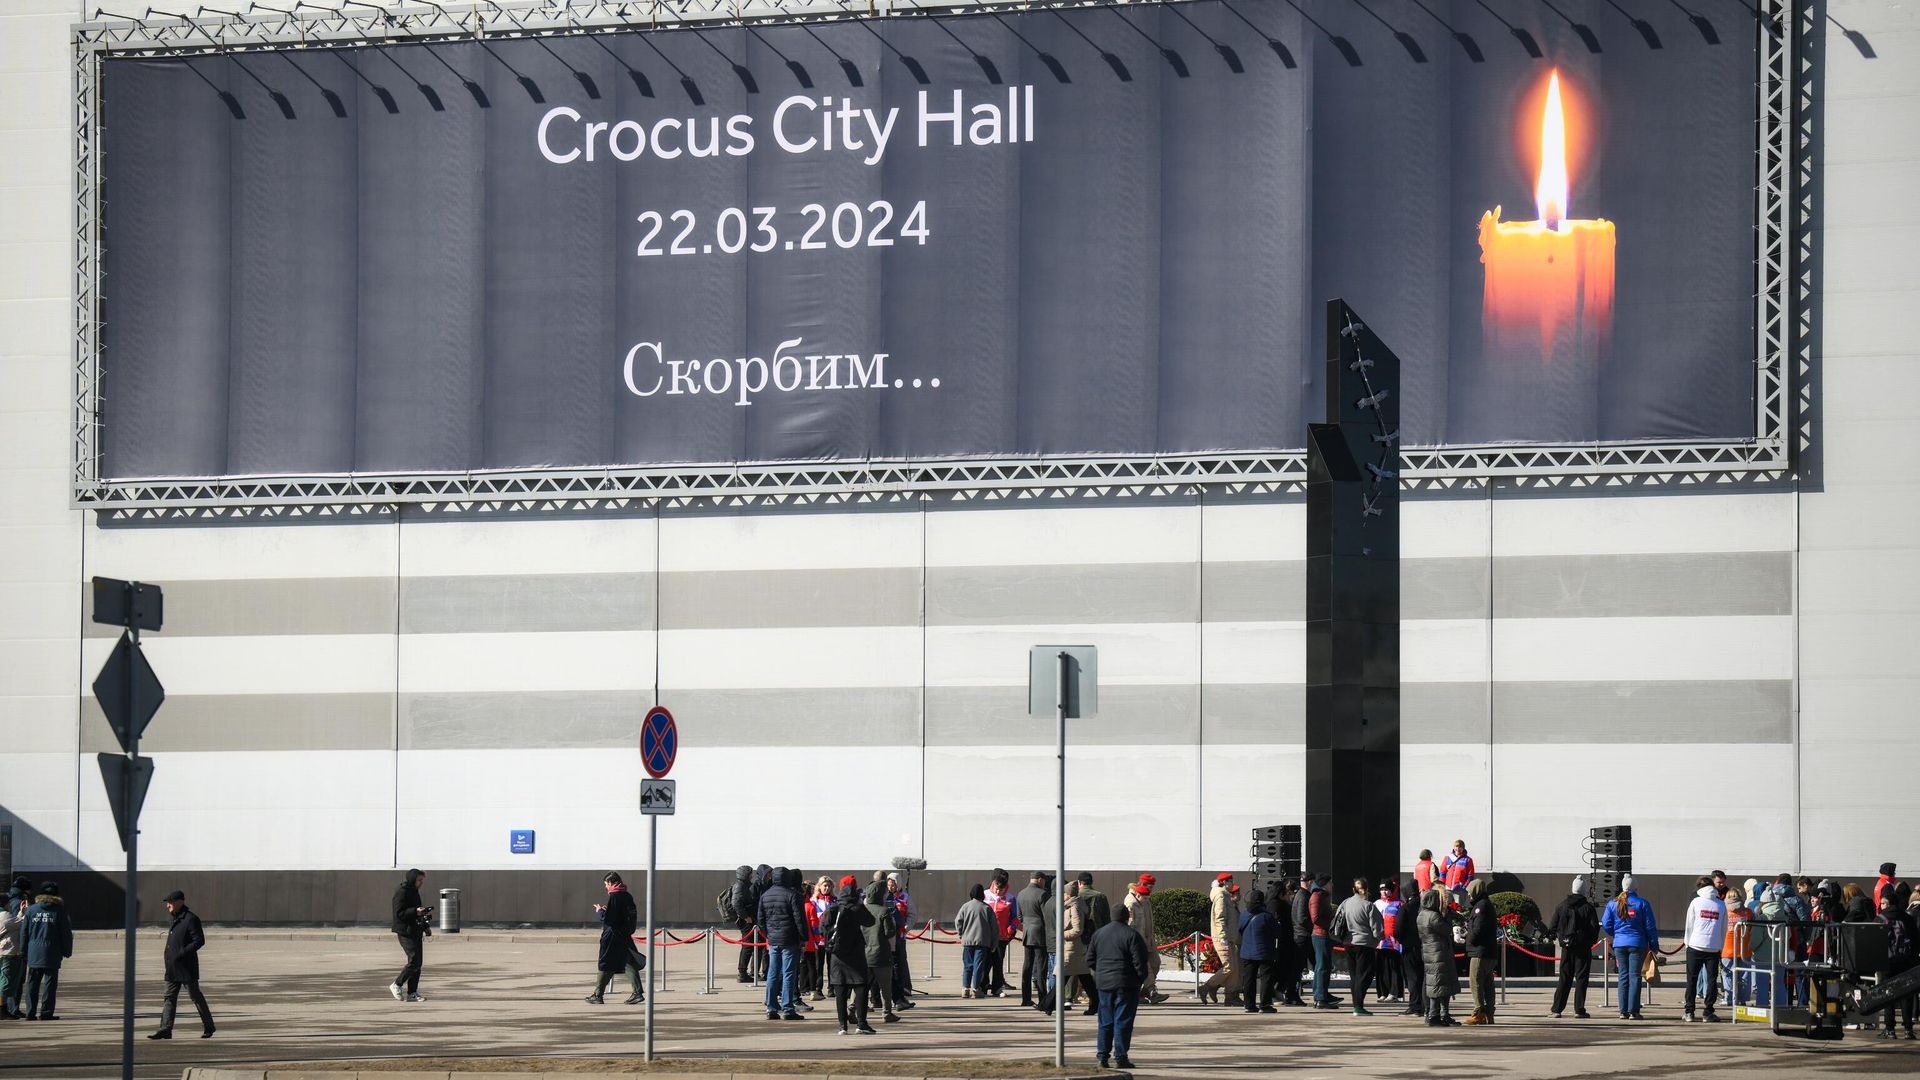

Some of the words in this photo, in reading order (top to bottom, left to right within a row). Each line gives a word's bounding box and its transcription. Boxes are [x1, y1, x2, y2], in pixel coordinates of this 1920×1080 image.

[537, 106, 755, 164] Crocus
[772, 95, 900, 166] City
[917, 84, 1035, 147] Hall
[636, 200, 931, 257] 22.03.2024
[623, 336, 942, 407] Скорбим...
